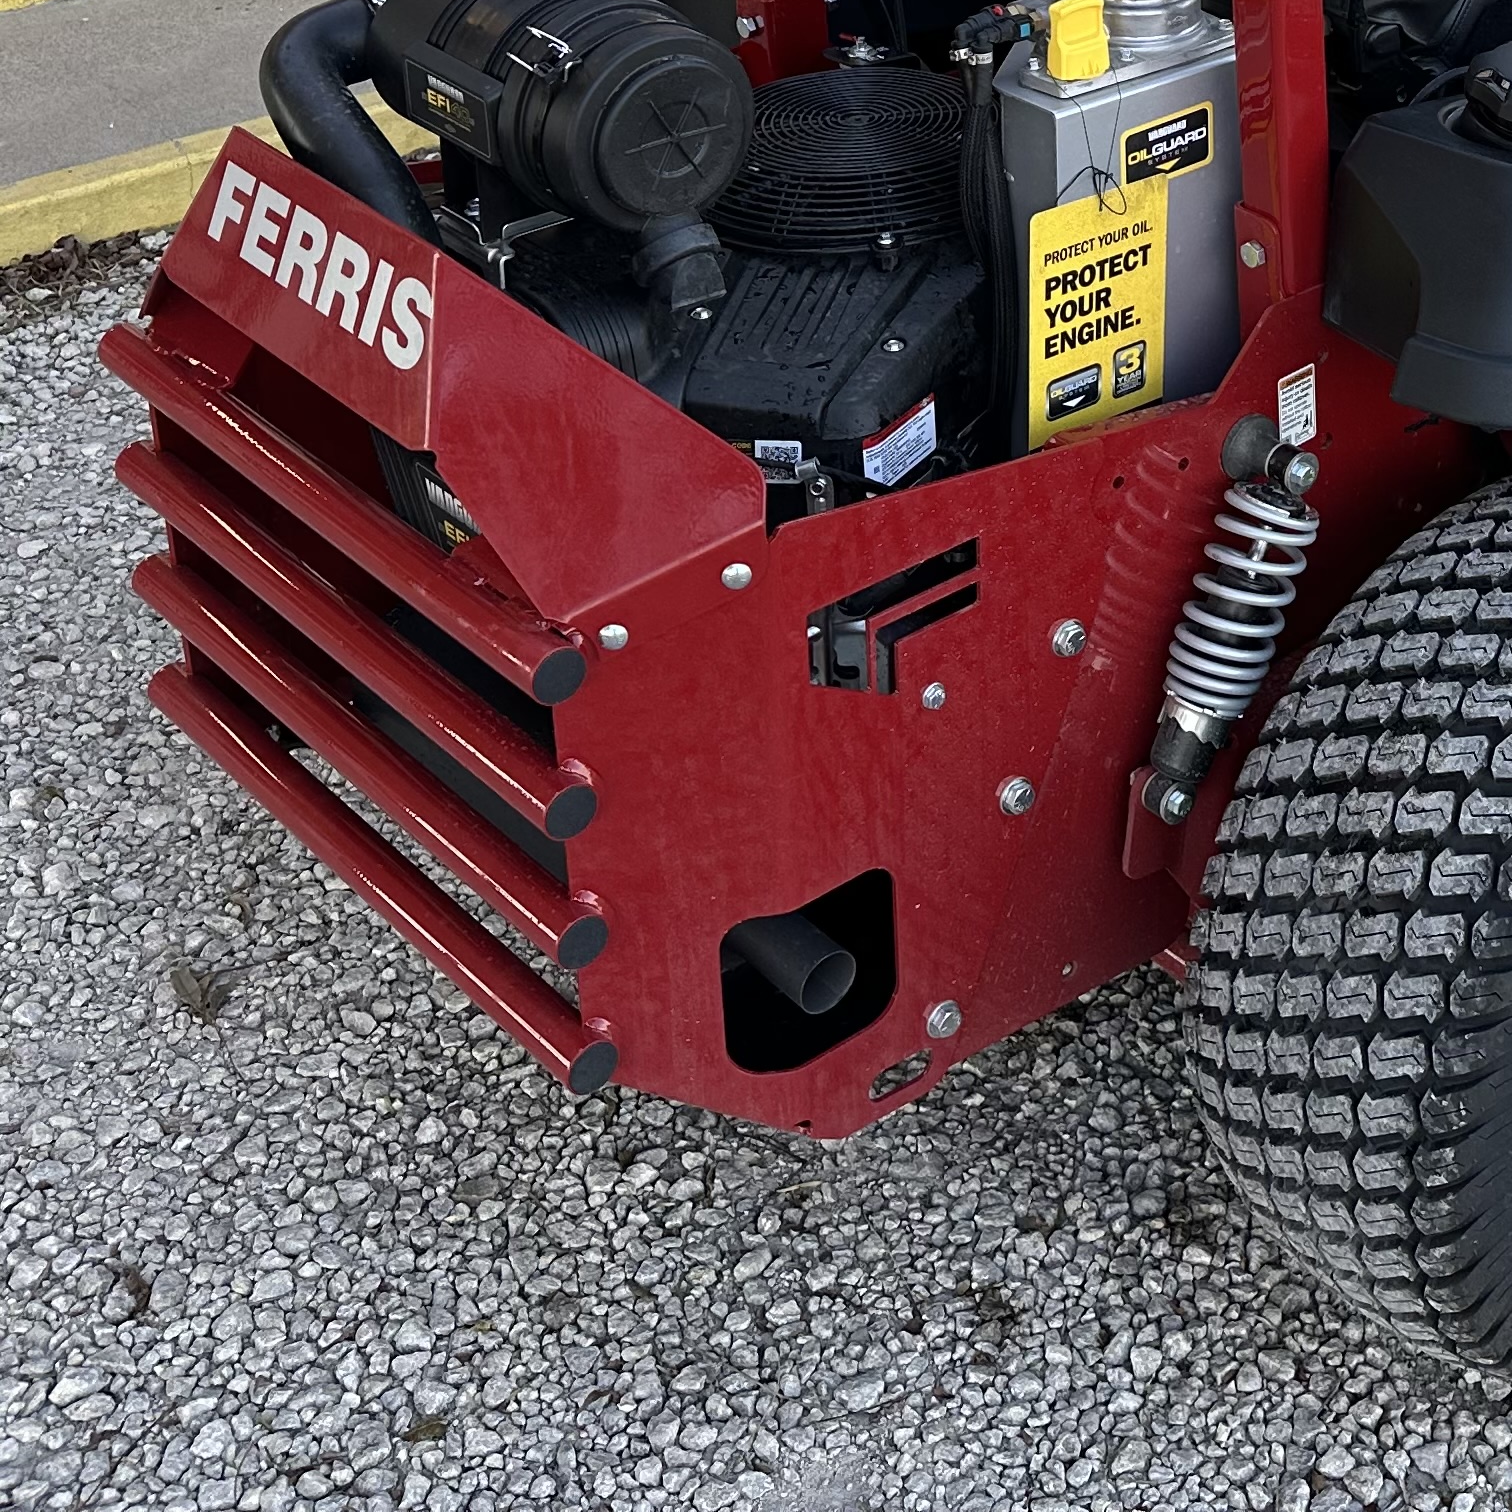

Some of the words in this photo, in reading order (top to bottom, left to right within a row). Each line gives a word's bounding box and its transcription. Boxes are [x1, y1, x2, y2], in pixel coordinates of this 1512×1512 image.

[1127, 126, 1207, 166] OILGUARD
[207, 160, 433, 370] FERRIS
[1044, 237, 1096, 267] PROTECT
[1097, 226, 1129, 248] YOUR
[1131, 219, 1154, 237] OIL.
[1044, 242, 1152, 301] PROTECT
[1044, 286, 1112, 329] YOUR
[1044, 305, 1142, 360] ENGINE.
[1119, 347, 1141, 375] 3
